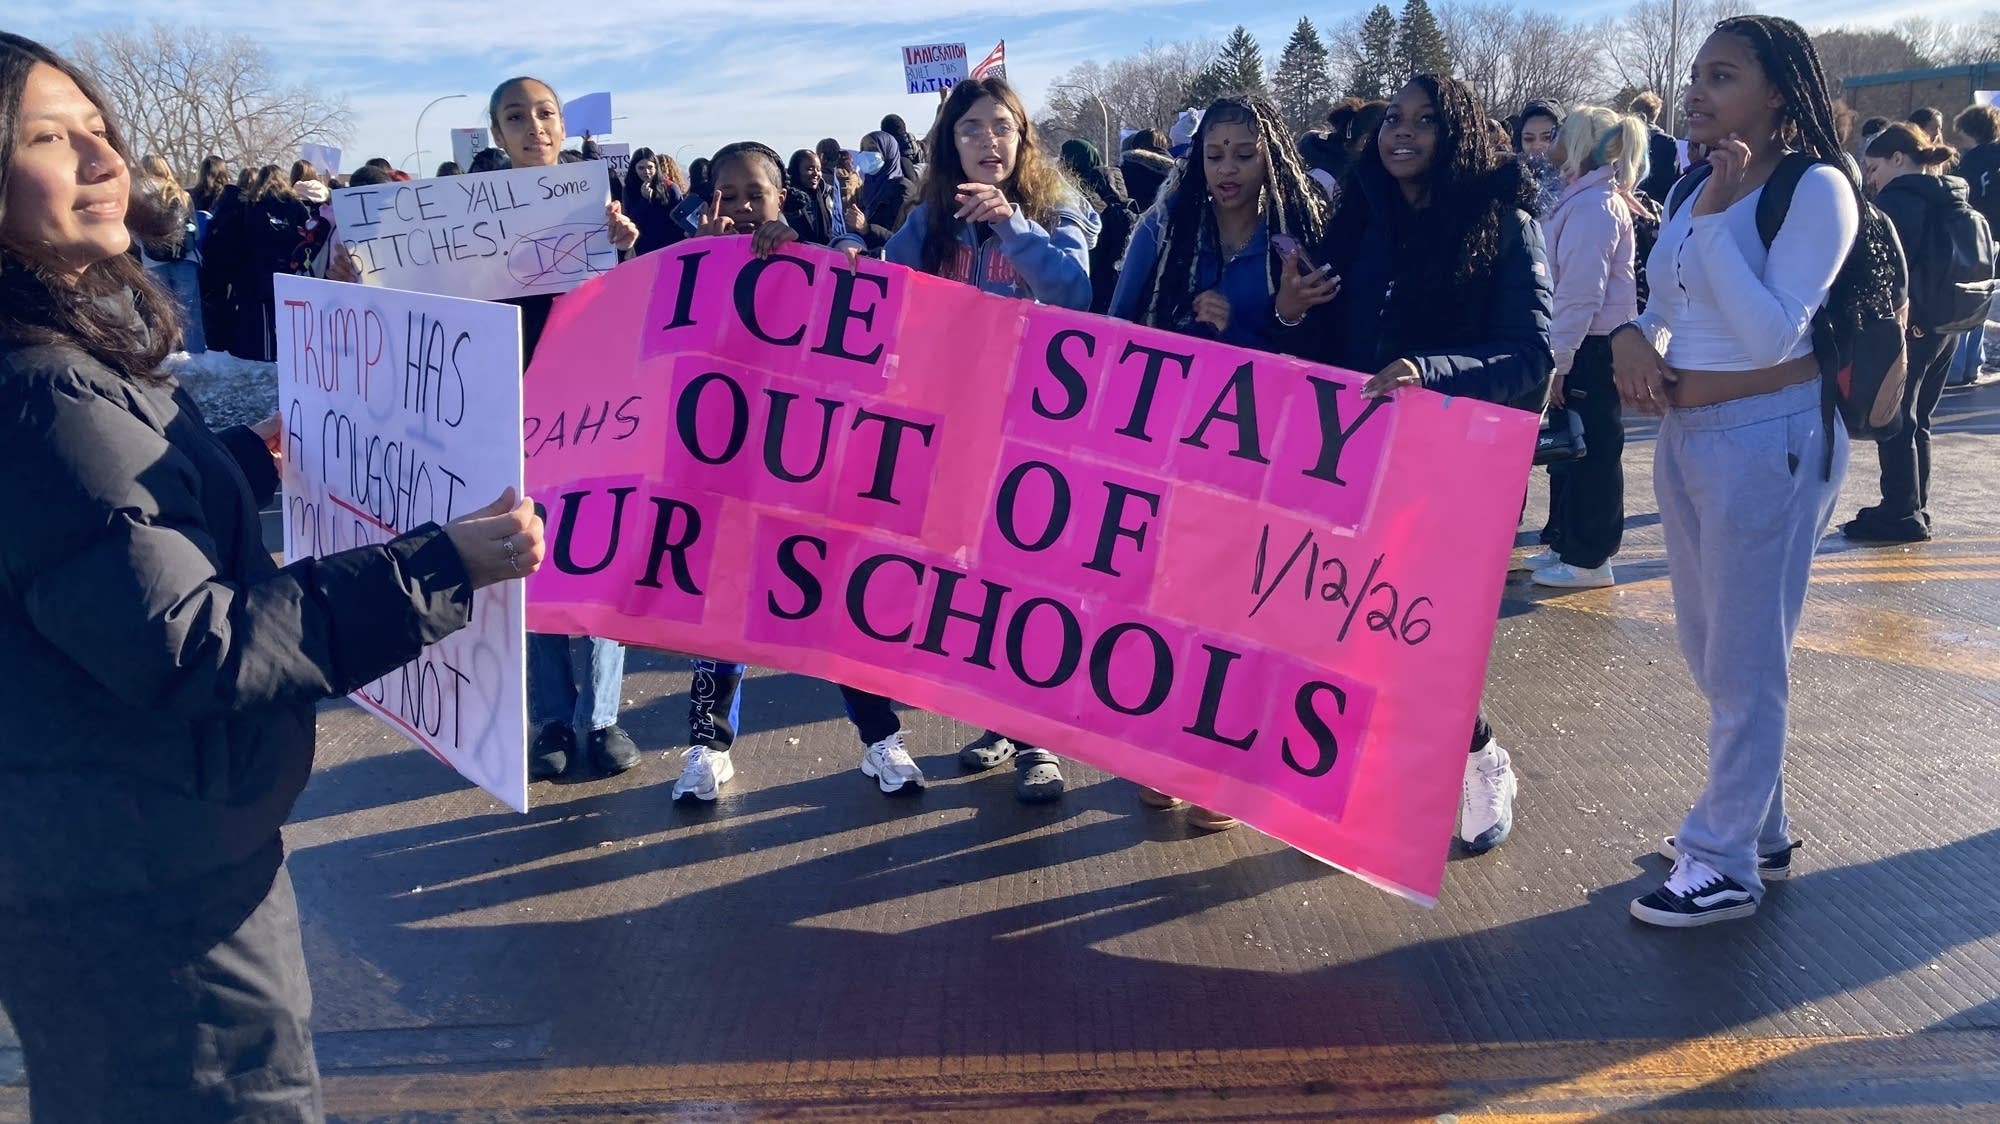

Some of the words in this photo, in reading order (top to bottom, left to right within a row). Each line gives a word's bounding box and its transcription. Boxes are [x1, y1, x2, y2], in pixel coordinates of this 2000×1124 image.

[905, 44, 967, 65] IMMIGRATION
[343, 219, 509, 276] BITCHES!
[457, 180, 530, 215] YALL
[537, 176, 590, 200] Some
[520, 229, 614, 278] ICE
[284, 300, 383, 402] TRUMP
[404, 310, 471, 428] HAS
[663, 250, 888, 365] ICE
[1031, 329, 1395, 488] STAY
[288, 398, 304, 473] A
[322, 409, 466, 534] MUGSHOT
[675, 371, 936, 505] OUT
[995, 460, 1161, 578] OF
[534, 486, 704, 596] UR
[767, 533, 1347, 778] SCHOOLS
[1248, 523, 1434, 646] 1/12/26
[401, 657, 471, 749] NOT
